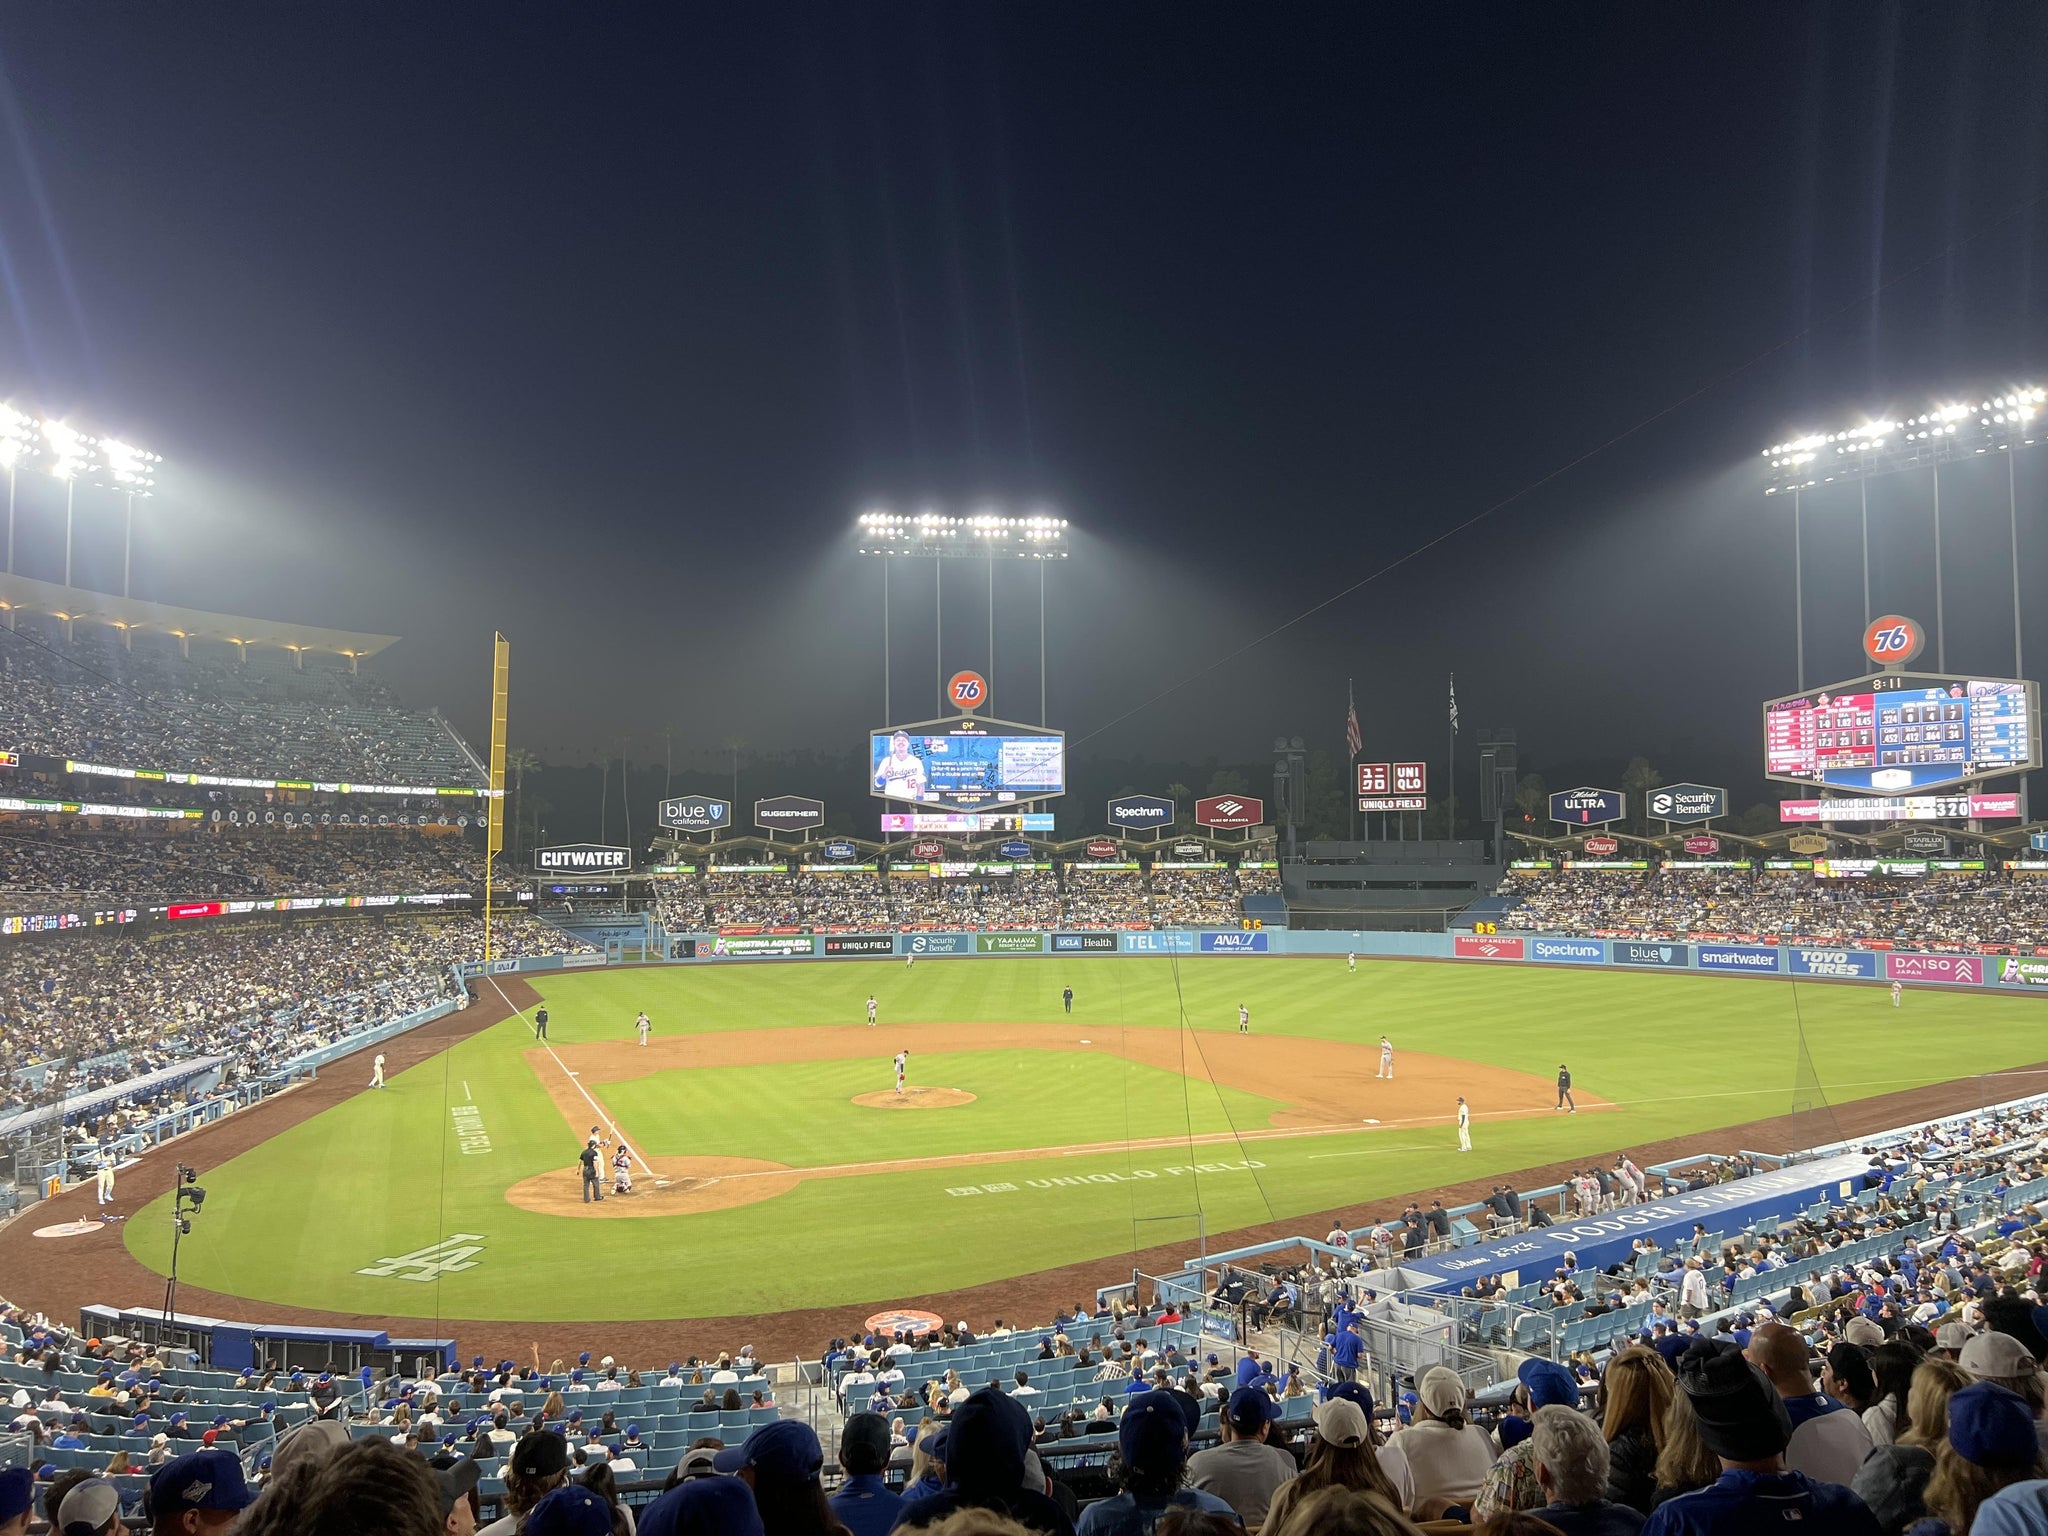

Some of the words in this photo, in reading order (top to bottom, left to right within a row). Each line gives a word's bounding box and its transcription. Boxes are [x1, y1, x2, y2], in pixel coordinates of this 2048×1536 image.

[1874, 624, 1907, 653] 76
[1873, 677, 1901, 690] 8:11
[956, 680, 980, 700] 76
[1856, 717, 1871, 726] 0.45
[1882, 715, 1898, 724] .324
[1907, 713, 1913, 722] 0
[1929, 712, 1935, 721] 4
[1950, 710, 1956, 720] 7
[1818, 738, 1832, 747] 17.2
[1840, 737, 1850, 746] 23
[1861, 736, 1867, 744] 2
[1882, 734, 1898, 743] .452
[1903, 733, 1919, 742] .412
[1949, 730, 1959, 739] 34
[1397, 766, 1419, 778] UNI
[350, 785, 374, 793] VOTED
[383, 786, 411, 794] CASINO
[907, 778, 917, 789] 12
[1397, 778, 1421, 790] QLO
[1362, 800, 1394, 810] UNIQLO
[1396, 799, 1422, 808] FIELD
[1564, 799, 1606, 810] ULTRA
[1675, 793, 1716, 804] Security
[666, 803, 705, 818] blue
[1115, 806, 1163, 818] Spectrum
[1676, 804, 1712, 814] Benefit
[1937, 803, 1946, 817] 3
[1947, 802, 1957, 817] 2
[1959, 802, 1968, 816] 0
[672, 817, 710, 825] california
[1586, 841, 1615, 852] Churu
[1791, 836, 1805, 849] JIM
[1805, 834, 1824, 850] BEAM
[1907, 837, 1942, 845] STARLUX
[918, 844, 938, 854] JINRO
[541, 851, 623, 866] CUTWATER
[1862, 860, 1877, 868] UP
[1243, 919, 1262, 930] 0:15
[1476, 922, 1496, 934] 0:15
[727, 940, 770, 948] CHRISTINA
[770, 939, 811, 947] AGUILERA
[842, 941, 868, 950] UNIQLO
[869, 941, 891, 949] FIELD
[928, 936, 957, 945] Security
[997, 936, 1037, 944] YAAMAVA'
[1059, 938, 1079, 947] UCLA
[1084, 937, 1112, 947] Health
[1126, 935, 1157, 949] TEL
[1213, 934, 1240, 946] ANA
[698, 944, 709, 954] 76
[929, 944, 953, 952] Benefit
[1536, 942, 1595, 958] Spectrum
[1630, 946, 1658, 959] blue
[1702, 952, 1774, 966] smartwater
[1801, 951, 1847, 964] TOYO
[496, 963, 511, 972] ANA
[1808, 961, 1863, 976] TIRES
[1895, 958, 1950, 971] DAISO
[1025, 1169, 1158, 1188] UNIQLO
[1164, 1160, 1267, 1176] FIELD
[1546, 1205, 1686, 1243] DODGER
[1680, 1175, 1806, 1208] STADIUM
[352, 1232, 488, 1282] LA
[1437, 1257, 1491, 1270] Welcome
